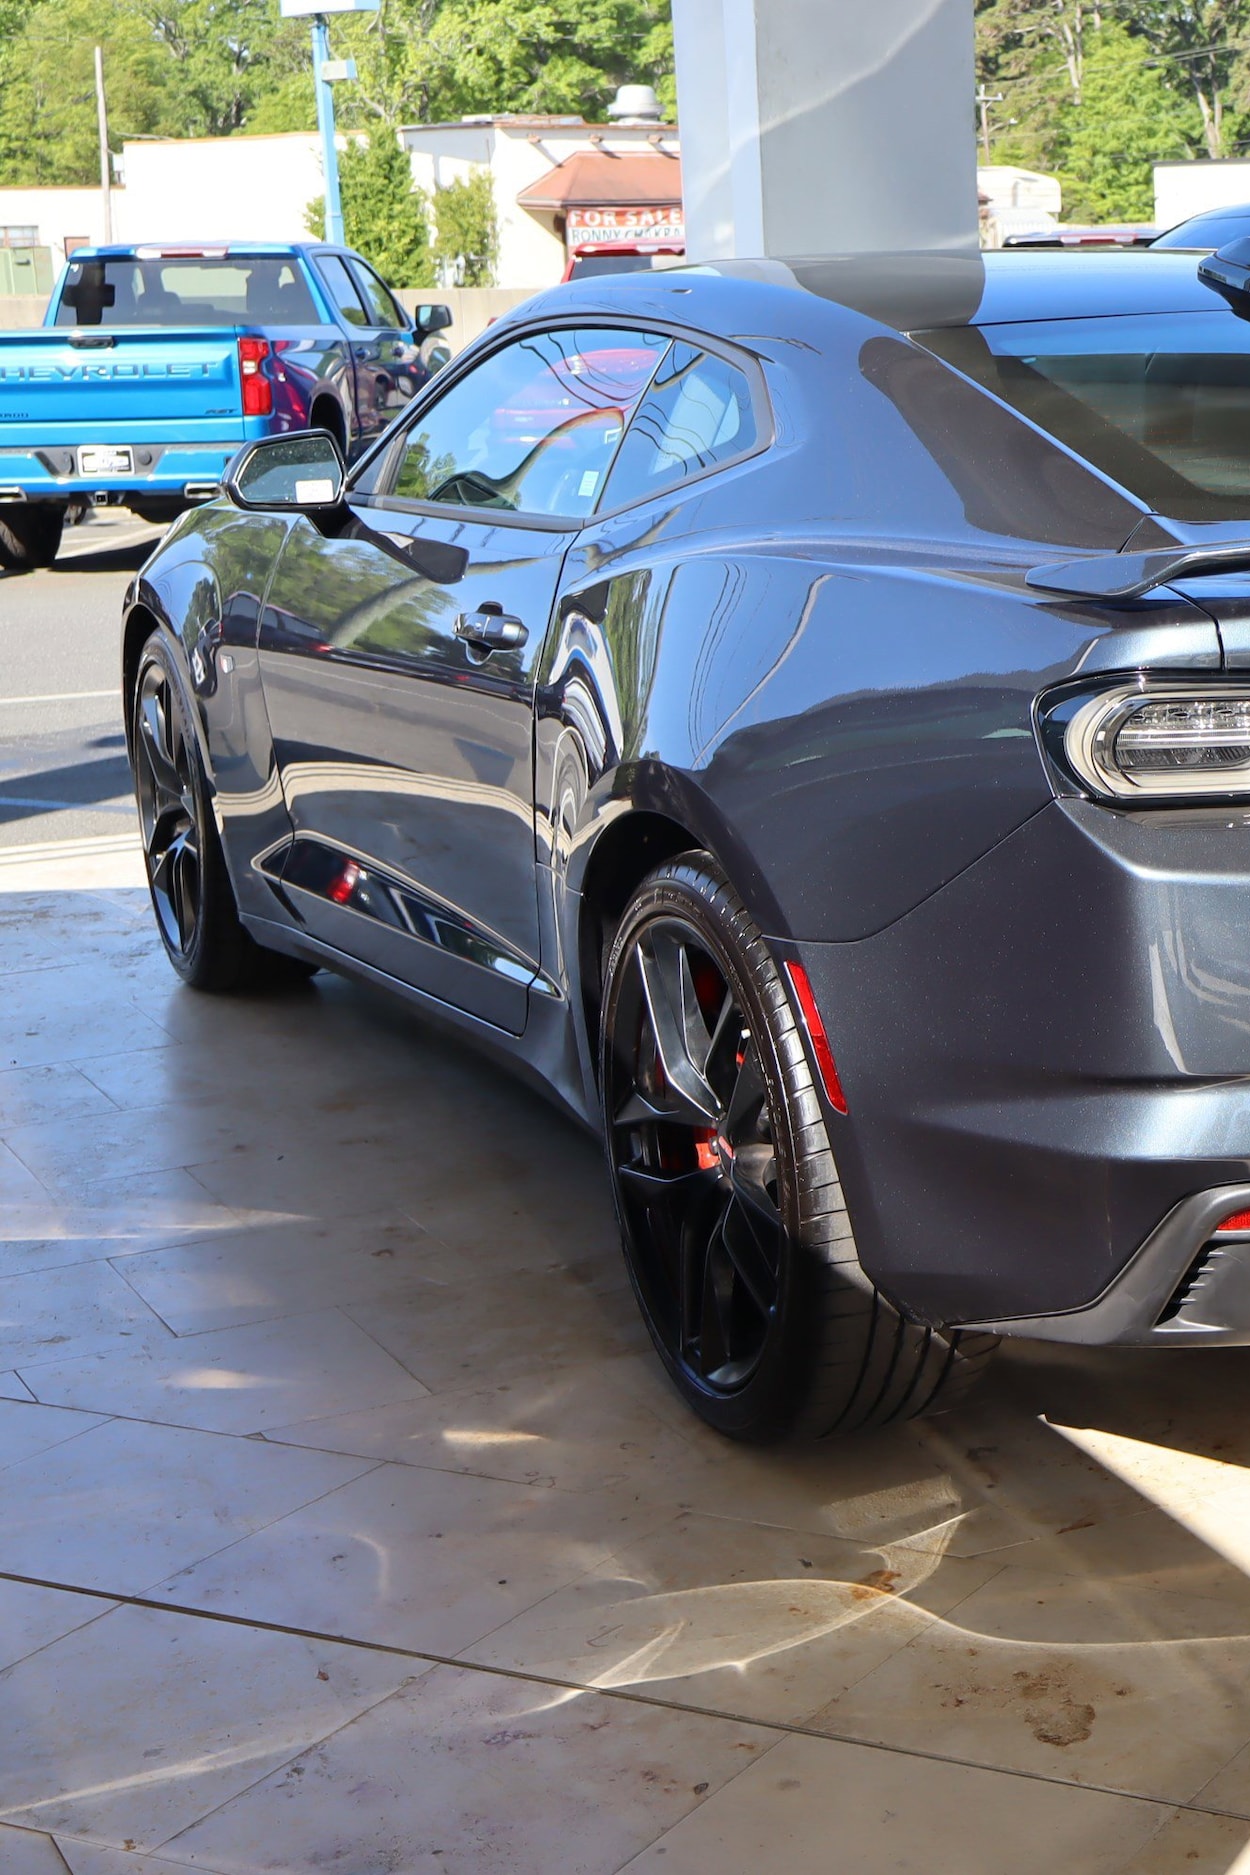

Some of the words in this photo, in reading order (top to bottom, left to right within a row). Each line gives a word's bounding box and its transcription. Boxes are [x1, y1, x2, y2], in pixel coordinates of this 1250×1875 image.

[569, 210, 617, 227] FOR
[625, 207, 681, 226] SALE
[0, 361, 217, 382] HEVROLET
